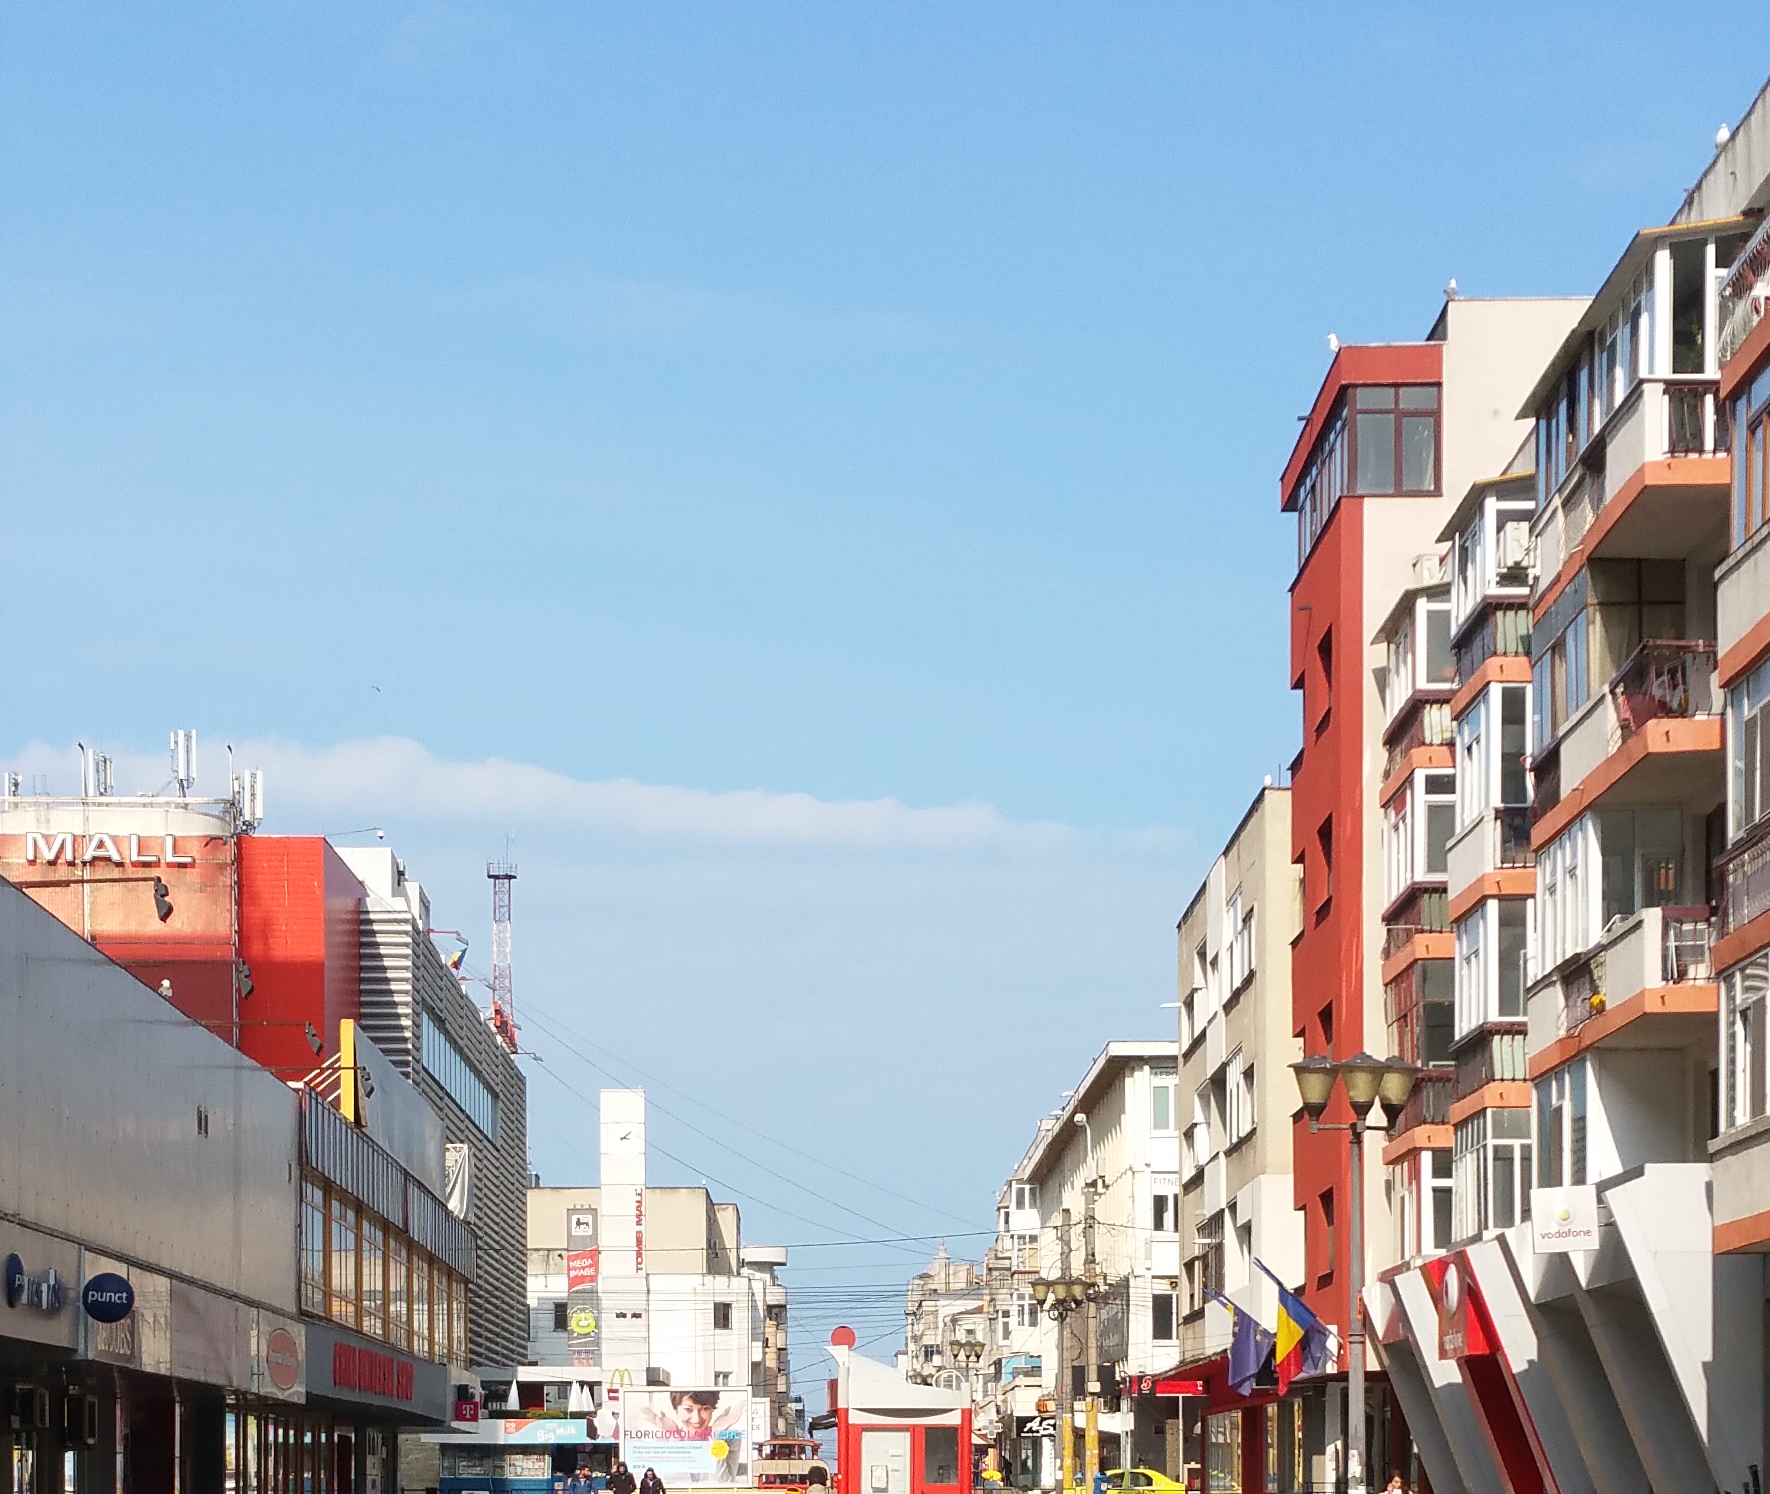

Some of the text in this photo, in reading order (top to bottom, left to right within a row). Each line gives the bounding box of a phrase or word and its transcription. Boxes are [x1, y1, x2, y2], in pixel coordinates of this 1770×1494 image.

[25, 831, 195, 864] MALL
[635, 1188, 644, 1273] TOMIS MALL
[1540, 1228, 1592, 1240] vodafone
[569, 1258, 594, 1268] MEGA
[570, 1266, 596, 1277] IMAGE
[88, 1290, 128, 1304] punct
[537, 1429, 555, 1442] Big
[556, 1425, 577, 1436] Milk
